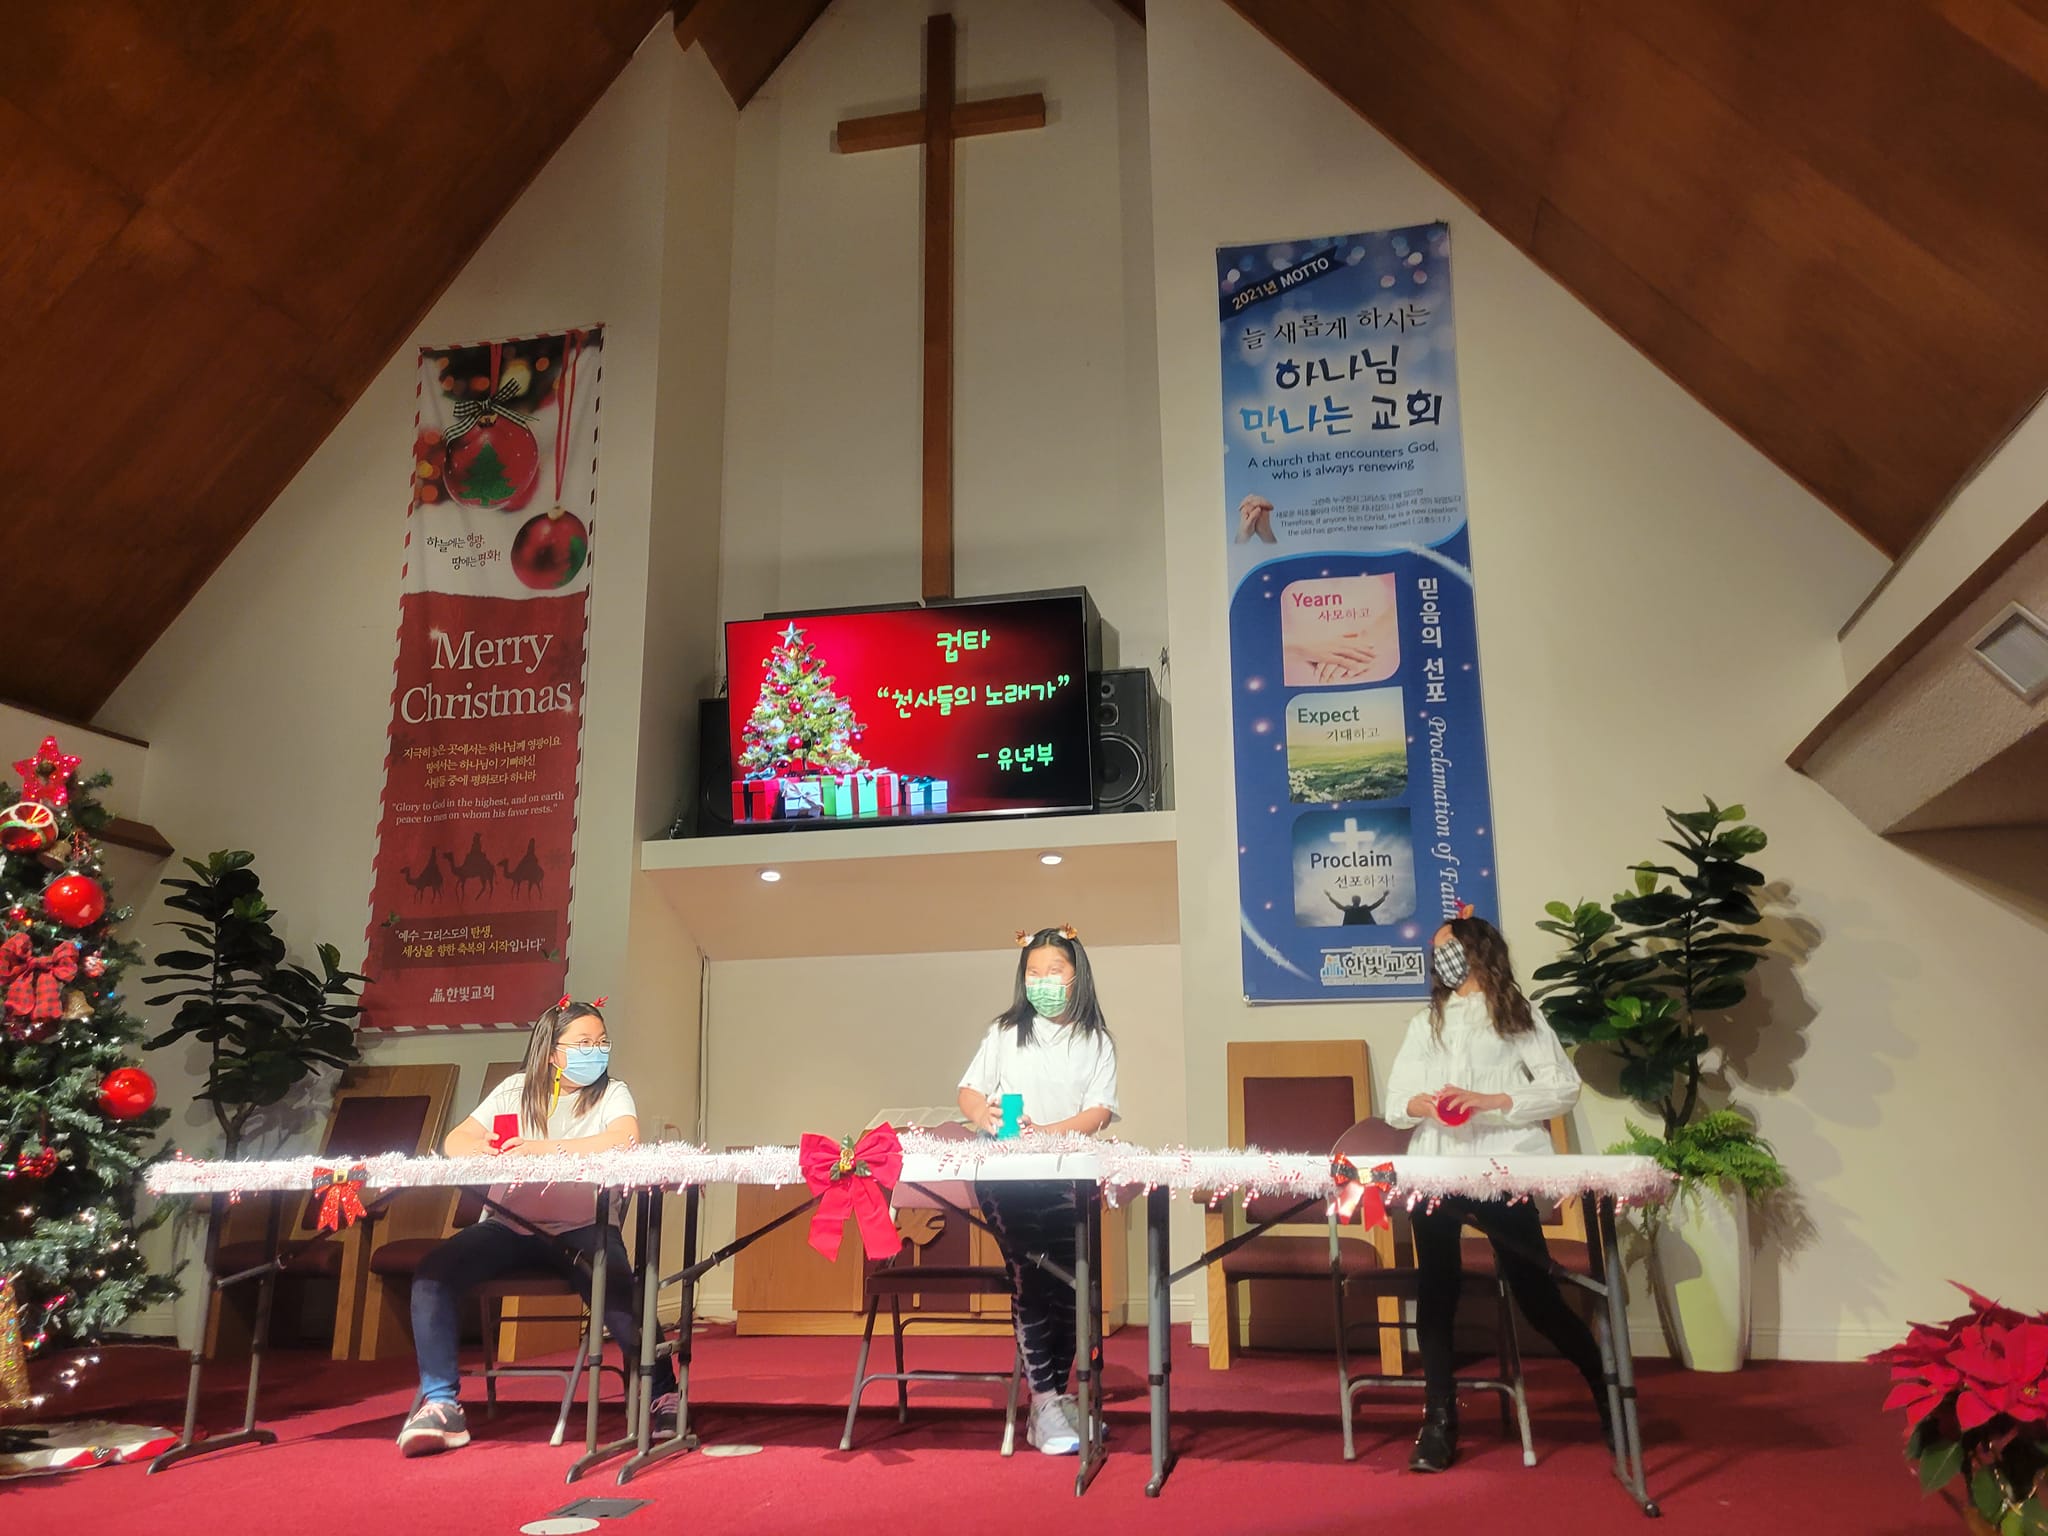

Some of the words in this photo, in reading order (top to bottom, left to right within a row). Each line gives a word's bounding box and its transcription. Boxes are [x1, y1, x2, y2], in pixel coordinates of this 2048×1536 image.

[1232, 280, 1279, 310] 2021년
[1280, 258, 1329, 288] MOTTO
[1242, 328, 1266, 350] 늘
[1274, 314, 1347, 344] 새롭게
[1357, 304, 1431, 335] 하시는
[1275, 344, 1399, 390] 하나님
[1239, 395, 1353, 444] 만나는
[1371, 389, 1443, 430] 교회
[1248, 458, 1258, 468] A
[1262, 454, 1303, 468] church
[1307, 451, 1331, 463] that
[1335, 447, 1404, 460] encounters
[1407, 440, 1439, 454] God,
[1272, 469, 1299, 481] who
[1303, 467, 1312, 478] is
[1315, 463, 1355, 477] always
[1359, 458, 1415, 473] renewing
[426, 536, 466, 553] 하늘에는
[452, 556, 477, 570] 땅에는
[478, 549, 501, 567] 평화!
[1292, 592, 1342, 608] Yearn
[1318, 608, 1370, 622] 사모하고
[1418, 577, 1442, 648] 믿음의
[431, 630, 554, 674] Merry
[936, 629, 991, 663] 컵타
[1423, 657, 1447, 703] 선포
[401, 682, 572, 724] Christmas
[877, 686, 976, 718] “천사들의
[986, 674, 1070, 706] 노래가”
[1297, 705, 1360, 726] Expect
[1326, 727, 1380, 742] 기대하고
[403, 746, 431, 760] 지극히
[448, 742, 488, 756] 곳에서는
[489, 739, 526, 753] 하나님께
[998, 743, 1054, 772] 유년부
[460, 757, 498, 771] 하나님이
[500, 754, 536, 769] 기뻐하신
[448, 774, 468, 787] 중에
[471, 772, 509, 787] 평화로다
[510, 769, 537, 784] 하니라
[1429, 716, 1454, 837] Proclamation
[423, 803, 431, 811] to
[432, 800, 445, 810] God
[447, 799, 455, 808] in
[457, 798, 473, 807] the
[475, 796, 509, 809] highest,
[511, 794, 527, 805] and
[528, 794, 539, 802] on
[541, 791, 564, 802] earth
[396, 815, 422, 826] peace
[423, 814, 432, 823] to
[448, 813, 460, 822] on
[462, 809, 491, 820] whom
[492, 807, 506, 818] his
[507, 807, 528, 817] favor
[1310, 850, 1392, 869] Proclaim
[1431, 842, 1460, 866] of
[1334, 873, 1396, 889] 선포하자!
[421, 926, 469, 940] 그리스도의
[402, 945, 435, 958] 세상을
[437, 944, 456, 957] 향한
[457, 942, 486, 956] 축복의
[1345, 954, 1423, 977] 한빛교회
[446, 985, 495, 1003] 한빛교회
